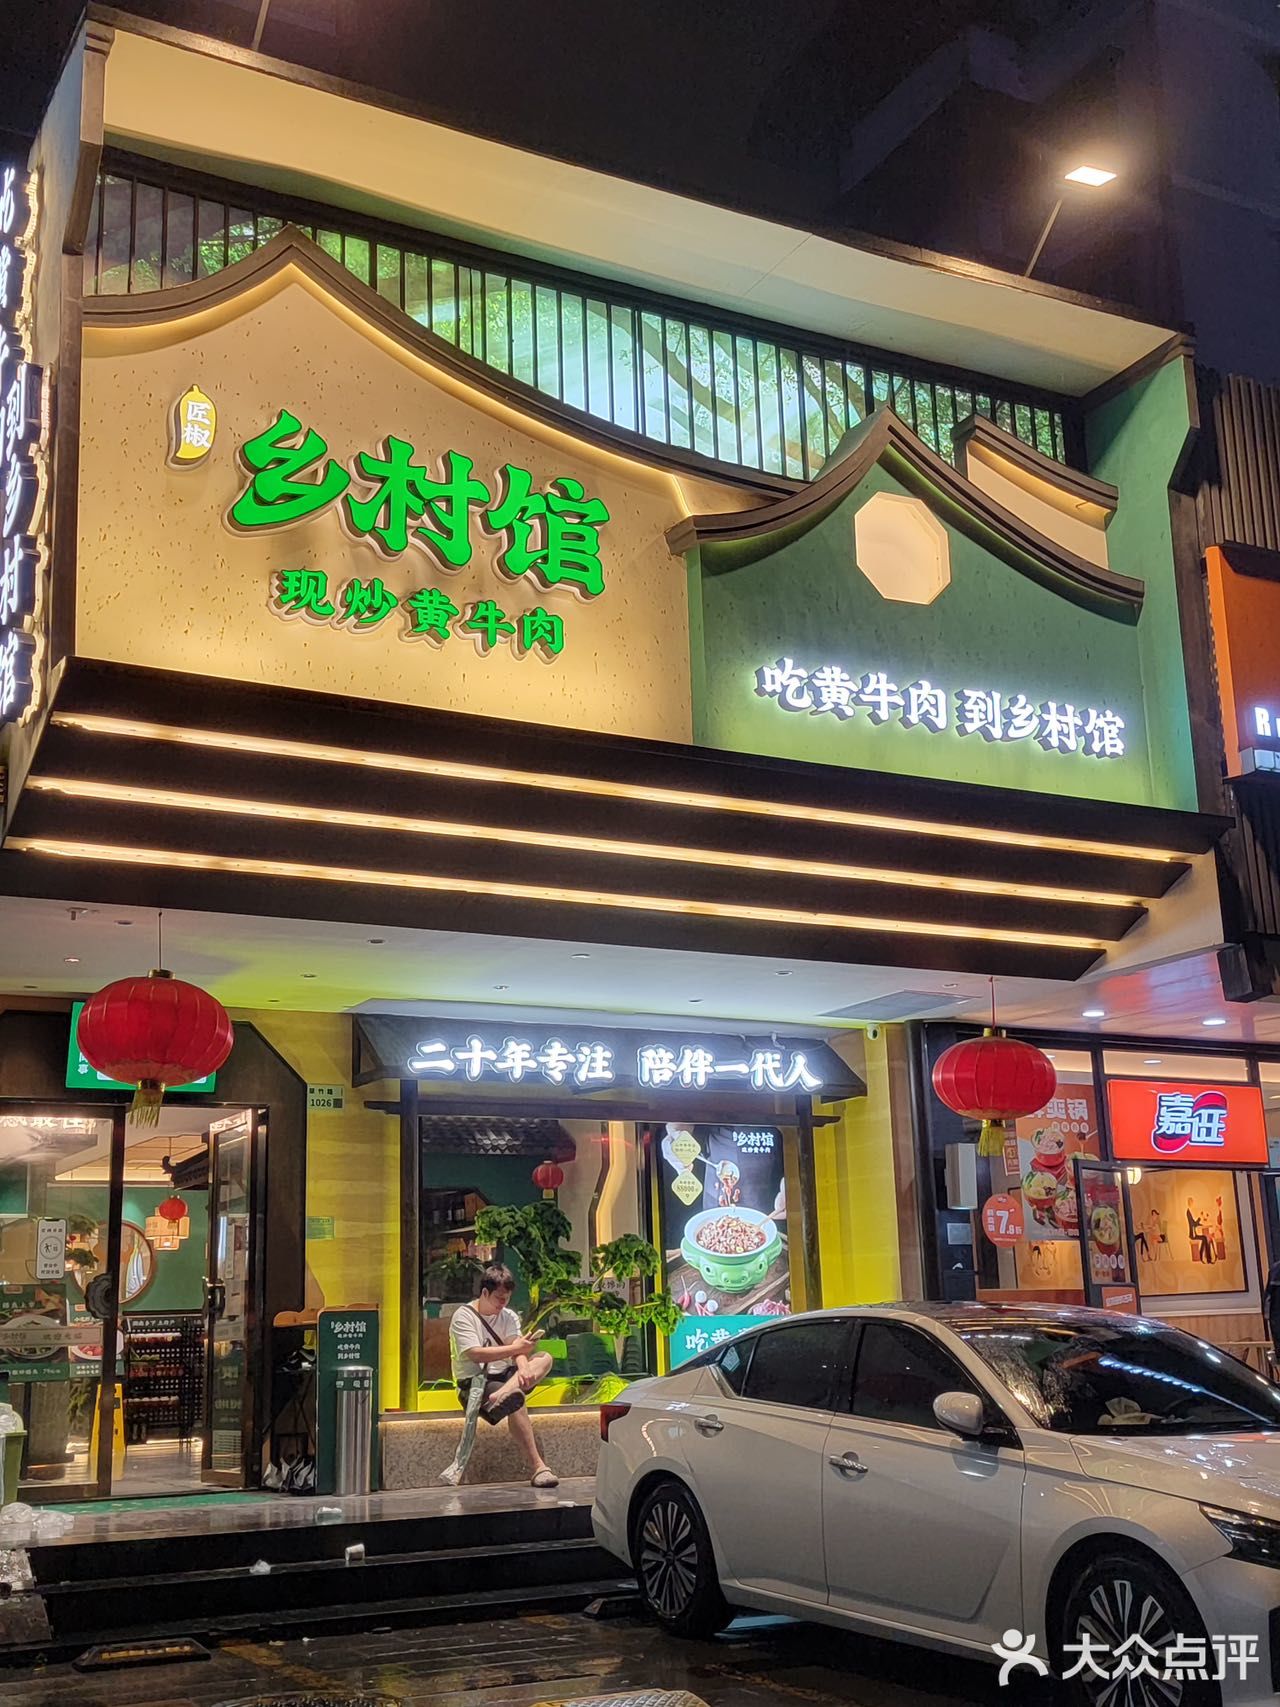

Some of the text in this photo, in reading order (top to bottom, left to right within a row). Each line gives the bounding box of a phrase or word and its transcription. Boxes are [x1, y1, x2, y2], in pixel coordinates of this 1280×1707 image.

[231, 408, 611, 596] 乡村馆
[279, 568, 565, 655] 现炒黄牛肉
[762, 657, 1126, 757] 吃黄牛肉 到乡村馆
[412, 1035, 823, 1090] 二十年专注 陪伴一代人
[310, 1099, 332, 1107] 1026
[334, 1321, 367, 1333] 乡村馆
